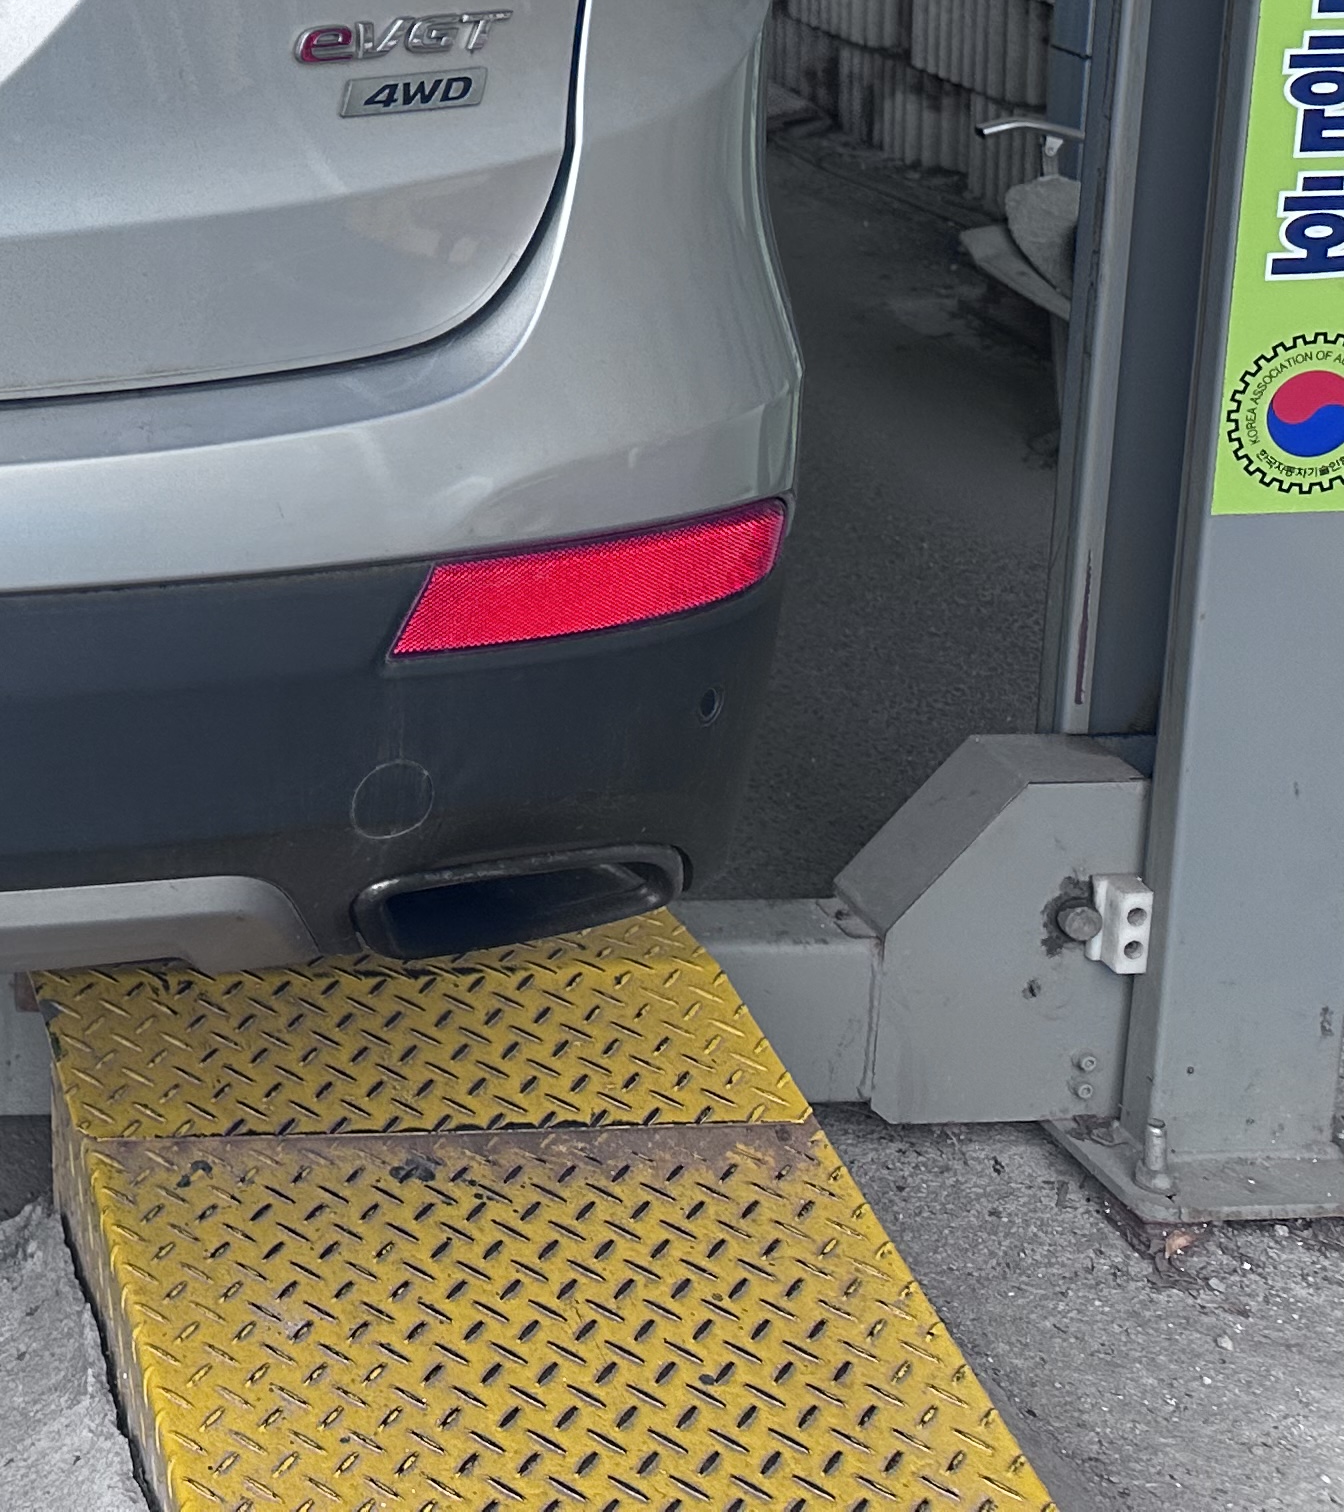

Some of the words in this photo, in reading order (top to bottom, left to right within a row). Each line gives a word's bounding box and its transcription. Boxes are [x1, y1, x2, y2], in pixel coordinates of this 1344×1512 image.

[363, 76, 473, 108] 4WD
[1316, 350, 1334, 361] OF
[1250, 351, 1313, 405] ASSOCIATION
[1246, 407, 1261, 446] KOREA
